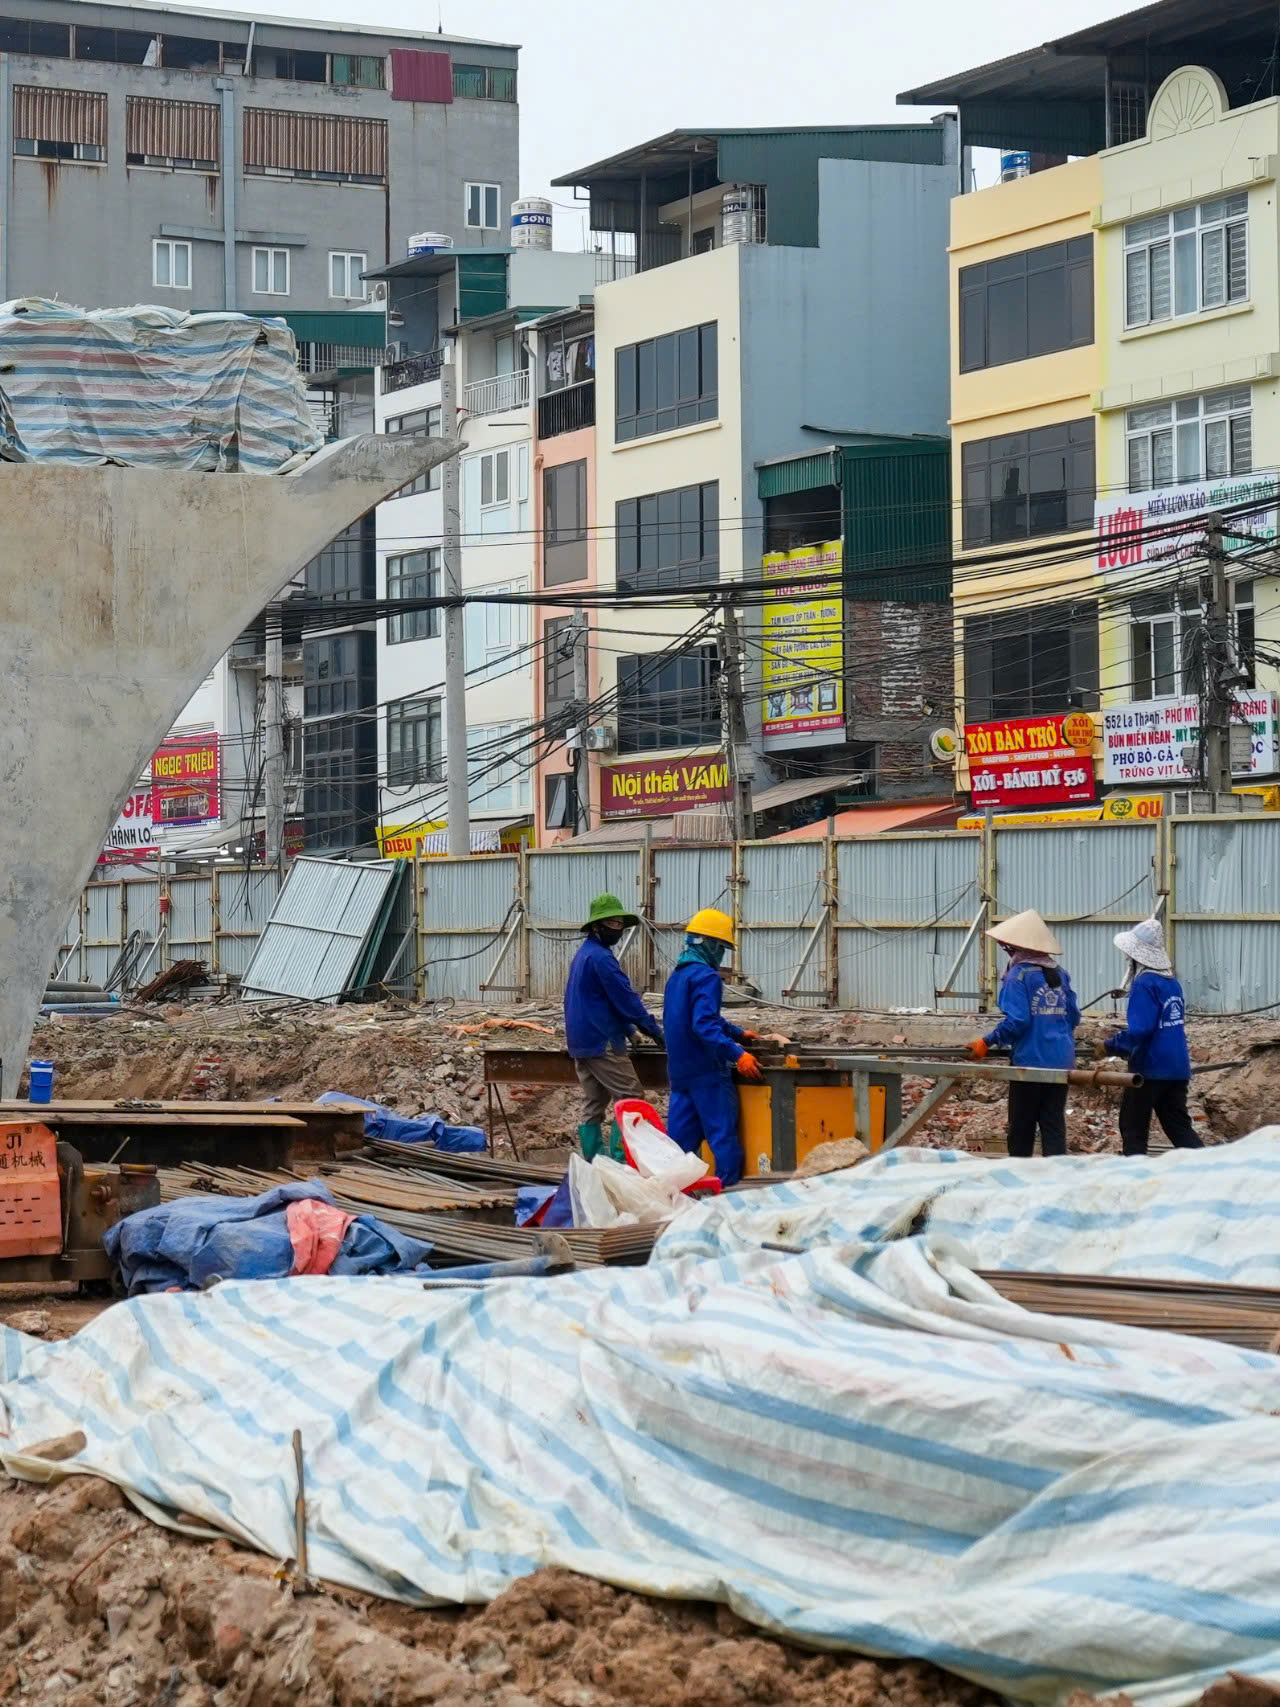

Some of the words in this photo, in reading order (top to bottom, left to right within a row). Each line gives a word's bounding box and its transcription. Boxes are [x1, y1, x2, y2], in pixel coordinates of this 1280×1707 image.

[1072, 716, 1088, 727] XÔI
[1105, 714, 1121, 729] 552
[1123, 713, 1133, 727] La
[967, 726, 994, 754] XÔI
[994, 723, 1026, 752] BÀN
[1026, 719, 1058, 749] THỜ
[1108, 732, 1125, 748] BÚN
[1126, 727, 1148, 747] MIẾN
[1148, 730, 1171, 745] NGAN
[155, 756, 182, 778] NGỌC
[184, 747, 214, 775] TRIỆU
[1120, 764, 1155, 779] TRỨNG
[1158, 765, 1174, 778] VỊT
[612, 771, 641, 799] Nội
[644, 766, 679, 793] thất
[972, 769, 997, 791] XÔI
[1003, 767, 1040, 789] BÁNH
[1063, 768, 1087, 787] 536
[1112, 801, 1131, 813] 552
[384, 837, 412, 855] DIỆU
